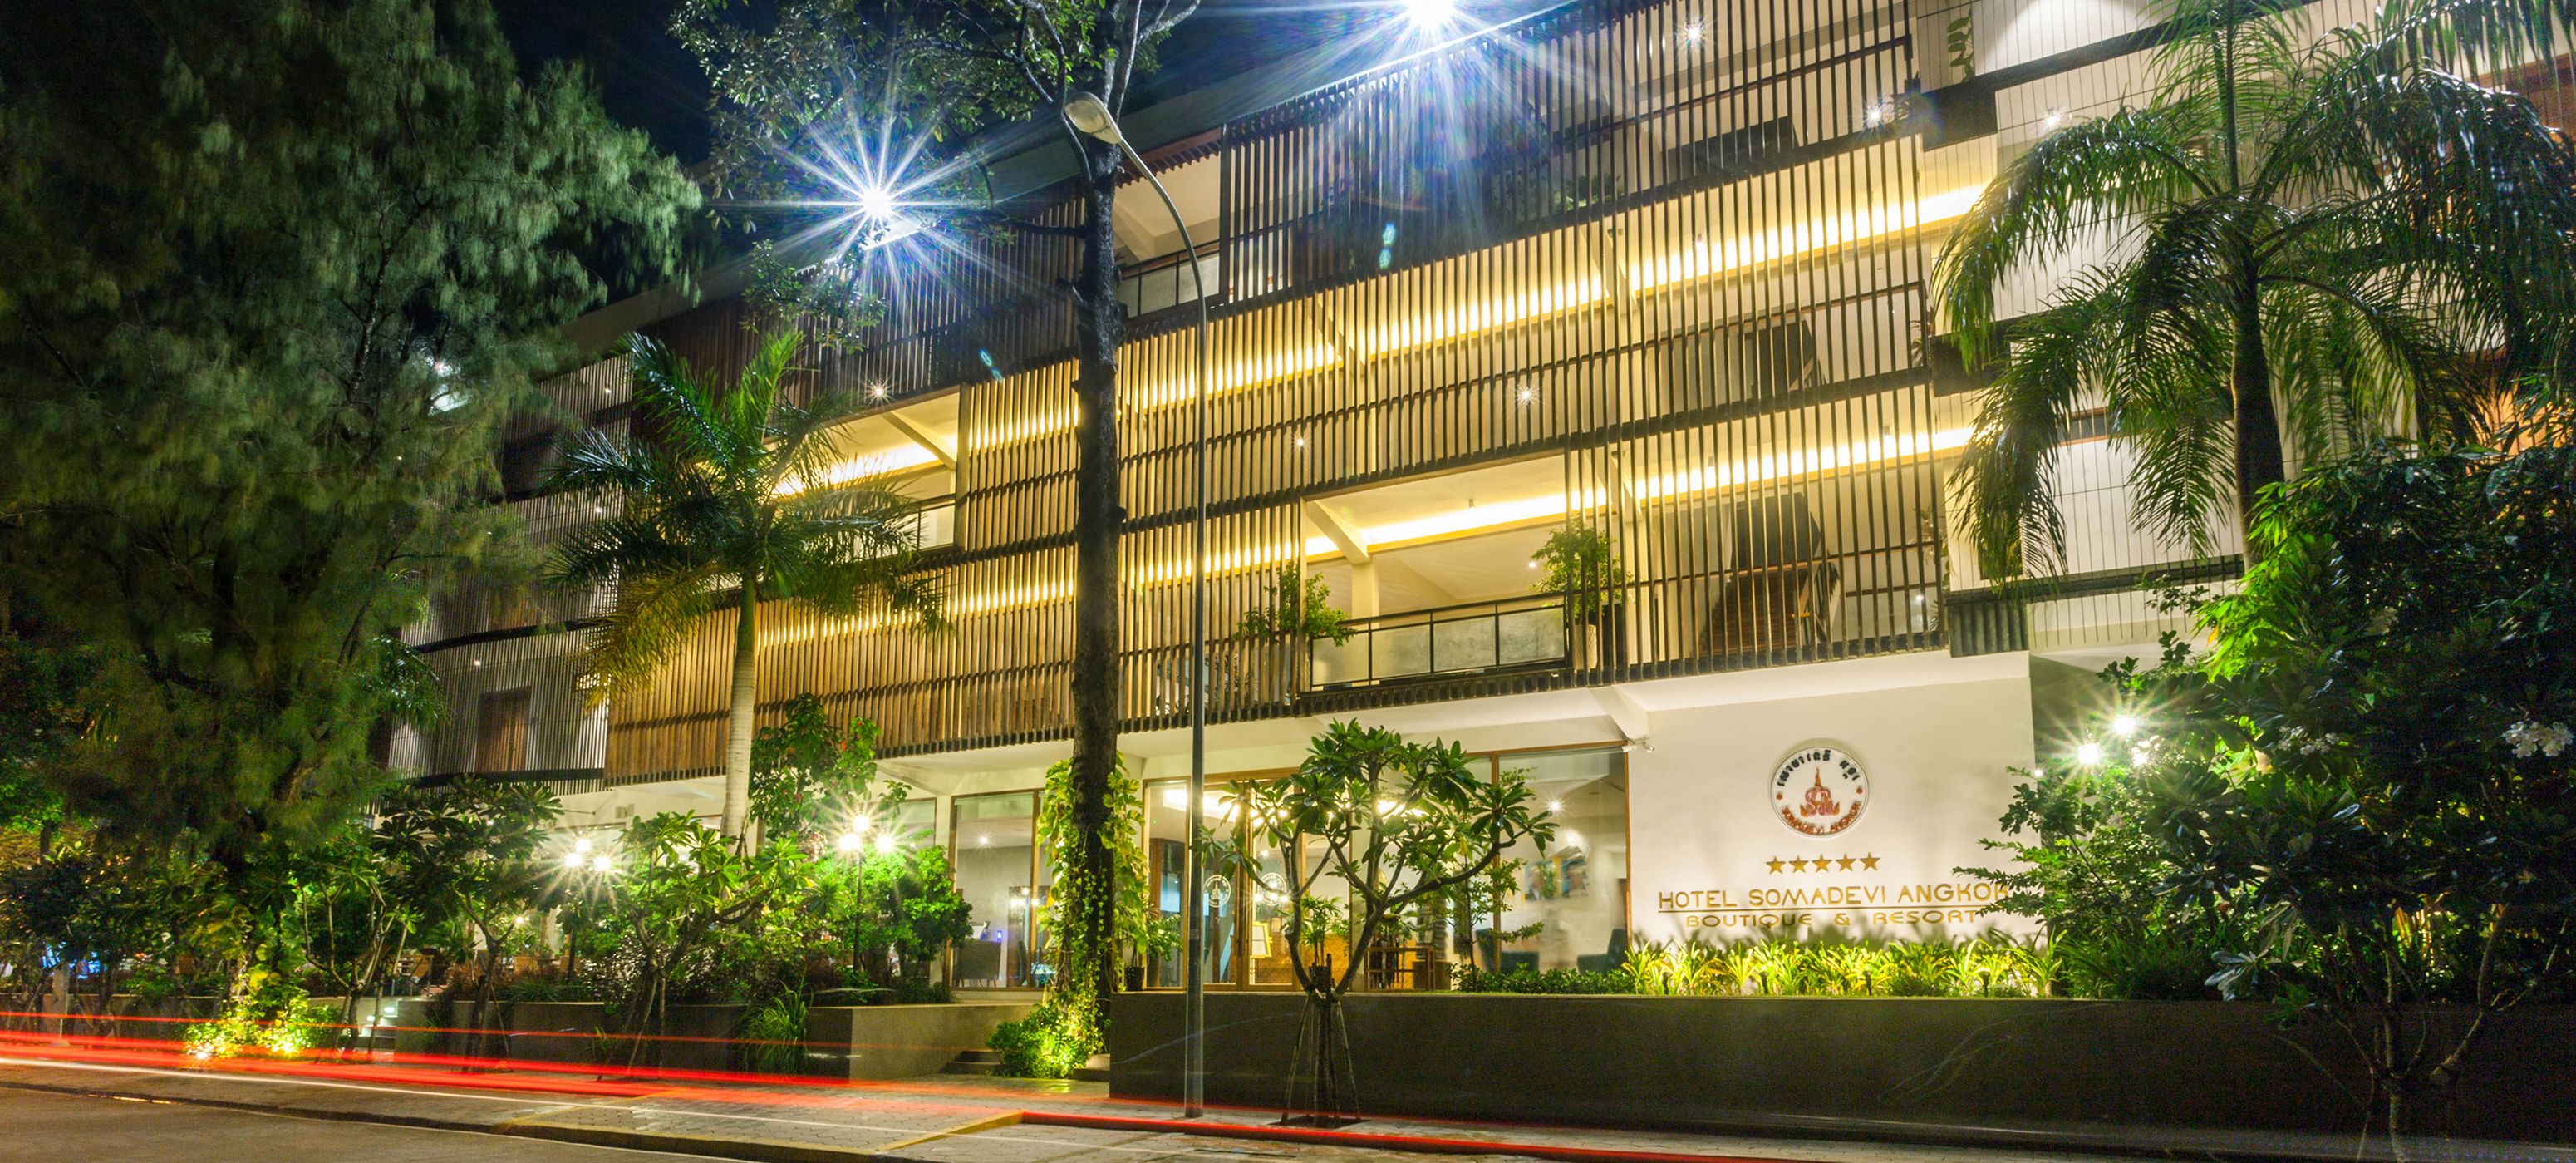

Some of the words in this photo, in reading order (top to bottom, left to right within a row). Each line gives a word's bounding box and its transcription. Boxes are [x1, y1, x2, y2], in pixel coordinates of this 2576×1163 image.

[1781, 806, 1825, 835] SOMADEVI
[1830, 801, 1861, 834] ANGKOR
[1659, 889, 1738, 909] HOTEL
[1748, 885, 1886, 907] SOMADEVI
[1897, 882, 2008, 904] ANGKOR
[1685, 913, 1812, 929] BOUTIQUE
[1834, 913, 1851, 926] &
[1872, 909, 1977, 925] RESORT
